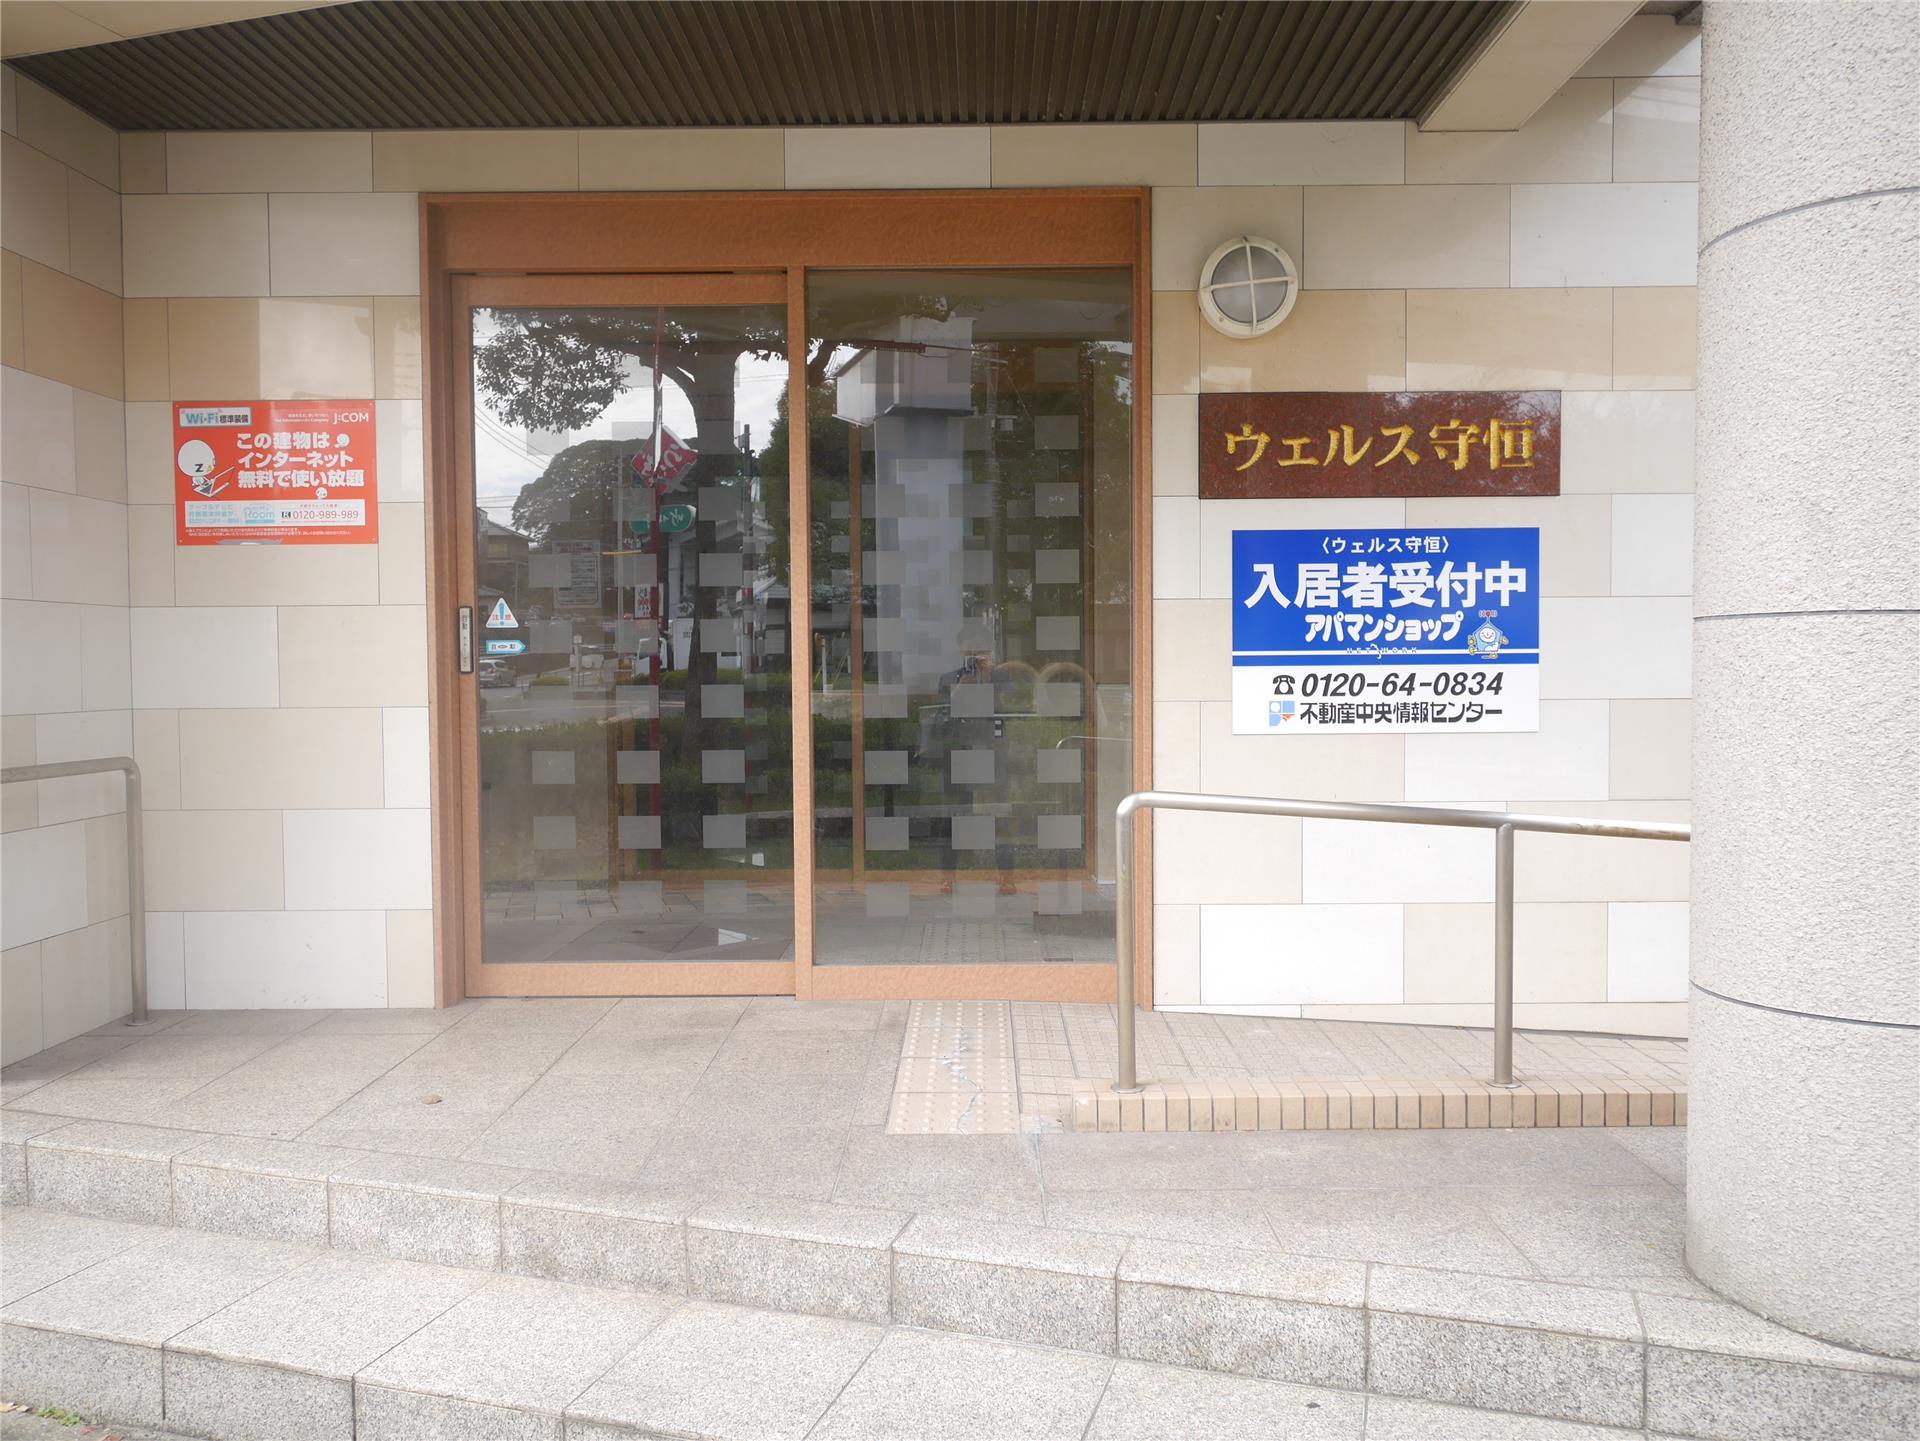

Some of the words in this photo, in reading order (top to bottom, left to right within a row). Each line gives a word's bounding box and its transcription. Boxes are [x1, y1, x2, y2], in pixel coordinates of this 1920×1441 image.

[332, 412, 369, 425] J:COM
[236, 432, 330, 449] この建物は
[1225, 417, 1535, 472] ウェルス守恒
[238, 451, 354, 468] インターネット
[237, 469, 365, 488] 無料で使い放題
[292, 511, 359, 520] 0120-989-989
[1244, 560, 1527, 609] 入居者受付中
[1304, 610, 1464, 642] アパマンショップ
[1301, 671, 1503, 697] 0120-64-0834
[1300, 701, 1503, 724] 不動産中央情報センター
